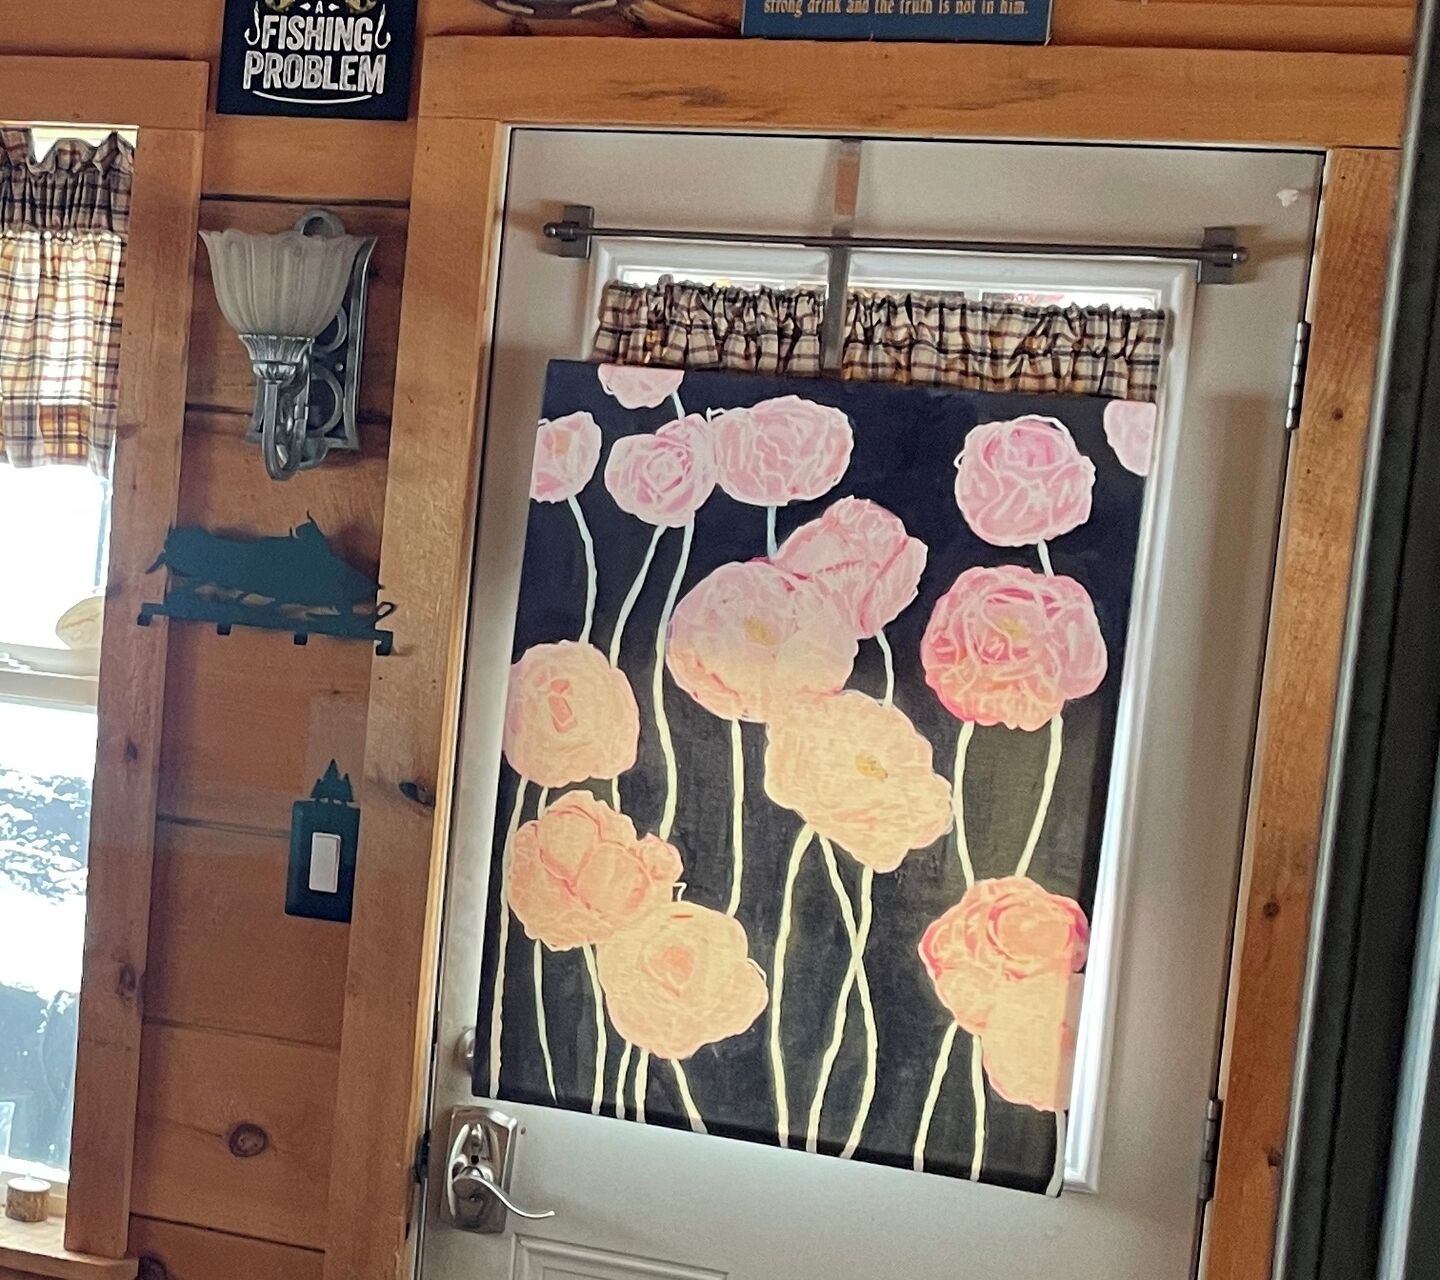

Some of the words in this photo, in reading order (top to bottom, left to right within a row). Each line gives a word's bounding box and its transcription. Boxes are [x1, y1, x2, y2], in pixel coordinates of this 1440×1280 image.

[316, 1, 323, 14] A
[261, 16, 373, 52] FISHING
[243, 51, 386, 94] PROBLEM
